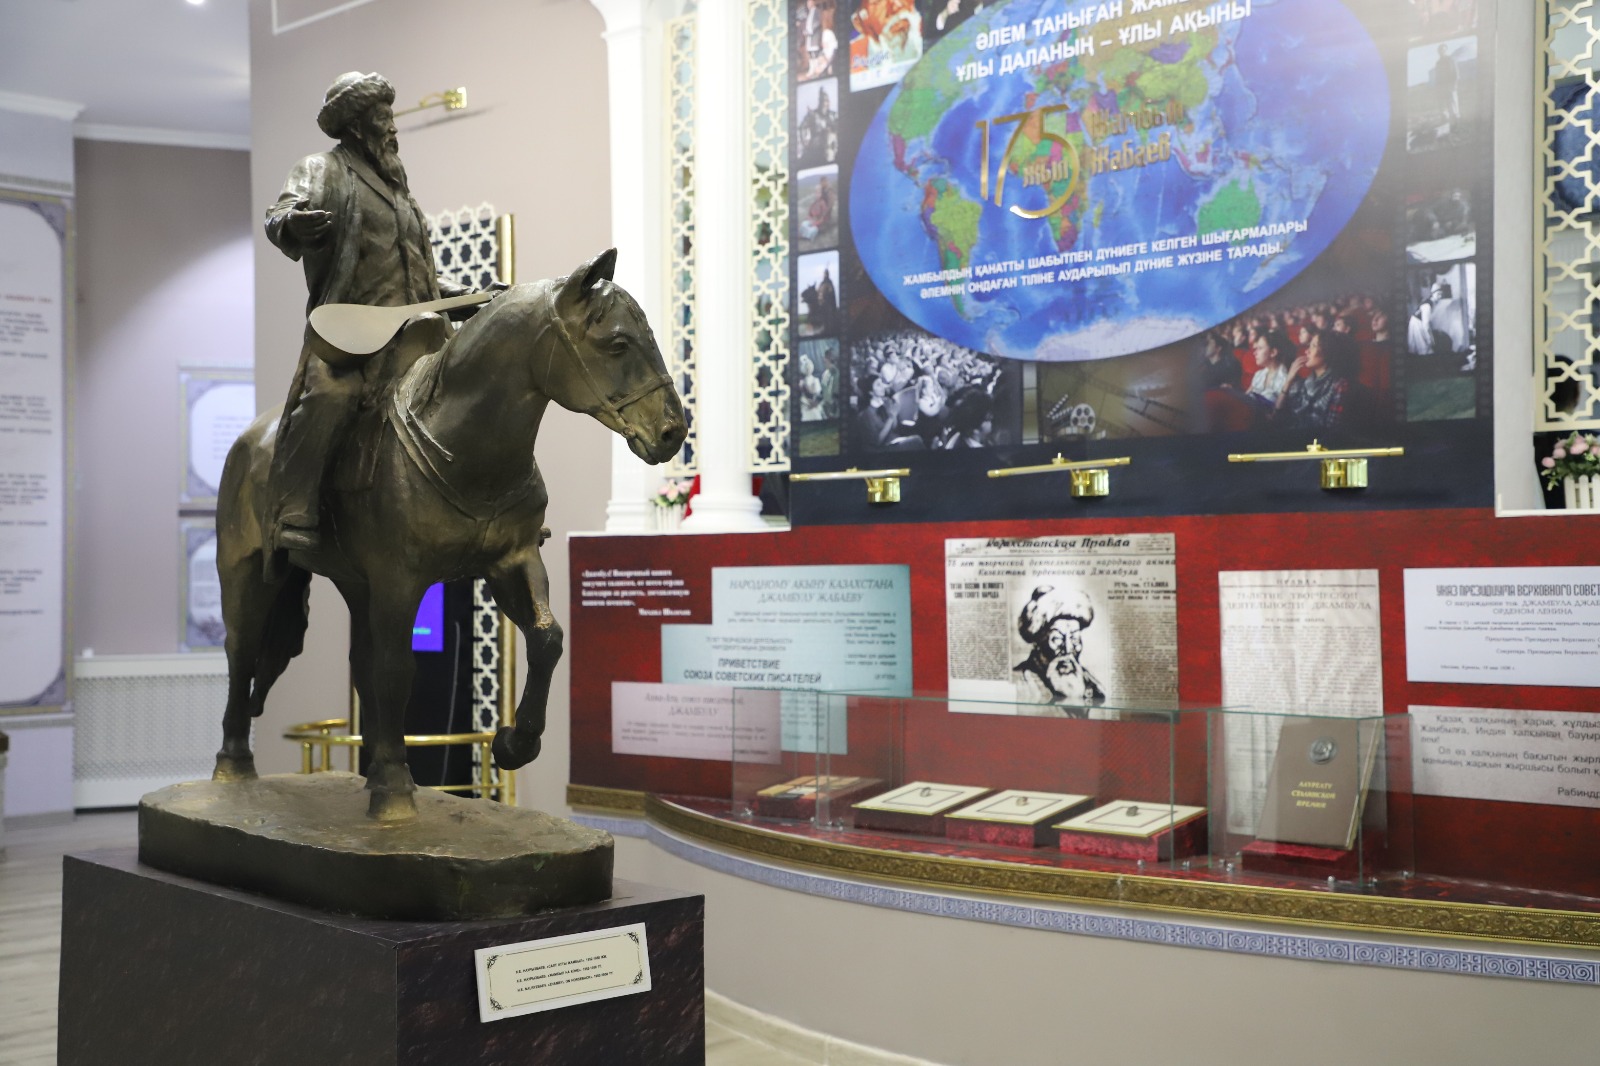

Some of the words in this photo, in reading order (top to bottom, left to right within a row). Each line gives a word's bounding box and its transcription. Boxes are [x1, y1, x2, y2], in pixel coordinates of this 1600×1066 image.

[975, 23, 1026, 51] ӘЛЕМ
[1031, 1, 1123, 38] ТАНЫҒАН
[955, 58, 994, 82] ҰЛЫ
[999, 36, 1094, 76] ДАЛАНЫҢ
[1118, 20, 1162, 46] ҰЛЫ
[1169, 0, 1252, 35] АҚЫНЫ
[975, 103, 1080, 220] 175
[903, 267, 973, 287] ЖАМБЫЛДЫҢ
[974, 259, 1025, 279] ҚАНАТТЫ
[1027, 250, 1093, 270] ШАБЫТПЕН
[1095, 241, 1148, 262] ДҮНИЕГЕ
[1151, 235, 1198, 253] КЕЛГЕН
[1201, 219, 1308, 246] ШЫҒАРМАЛАРЫ
[1020, 271, 1055, 287] ТІЛІНЕ
[1057, 260, 1131, 283] АУДАРЫЛЫП
[1133, 255, 1174, 275] ДҮНИЕ
[1226, 241, 1284, 260] ТАРАДЫ.
[1080, 537, 1131, 551] Правда
[828, 578, 894, 590] КАЗАХСТАНА
[1517, 583, 1572, 597] ВЕРХОВНОГО
[1521, 600, 1572, 608] ДЖАМБУЛА
[718, 657, 781, 670] ПРИВЕТСТВИЕ
[683, 669, 714, 681] СОЮЗА
[715, 671, 765, 683] СОВЕТСКИХ
[766, 672, 822, 684] ПИСАТЕЛЕЙ
[1523, 751, 1568, 762] бақытын
[1557, 763, 1591, 775] болып
